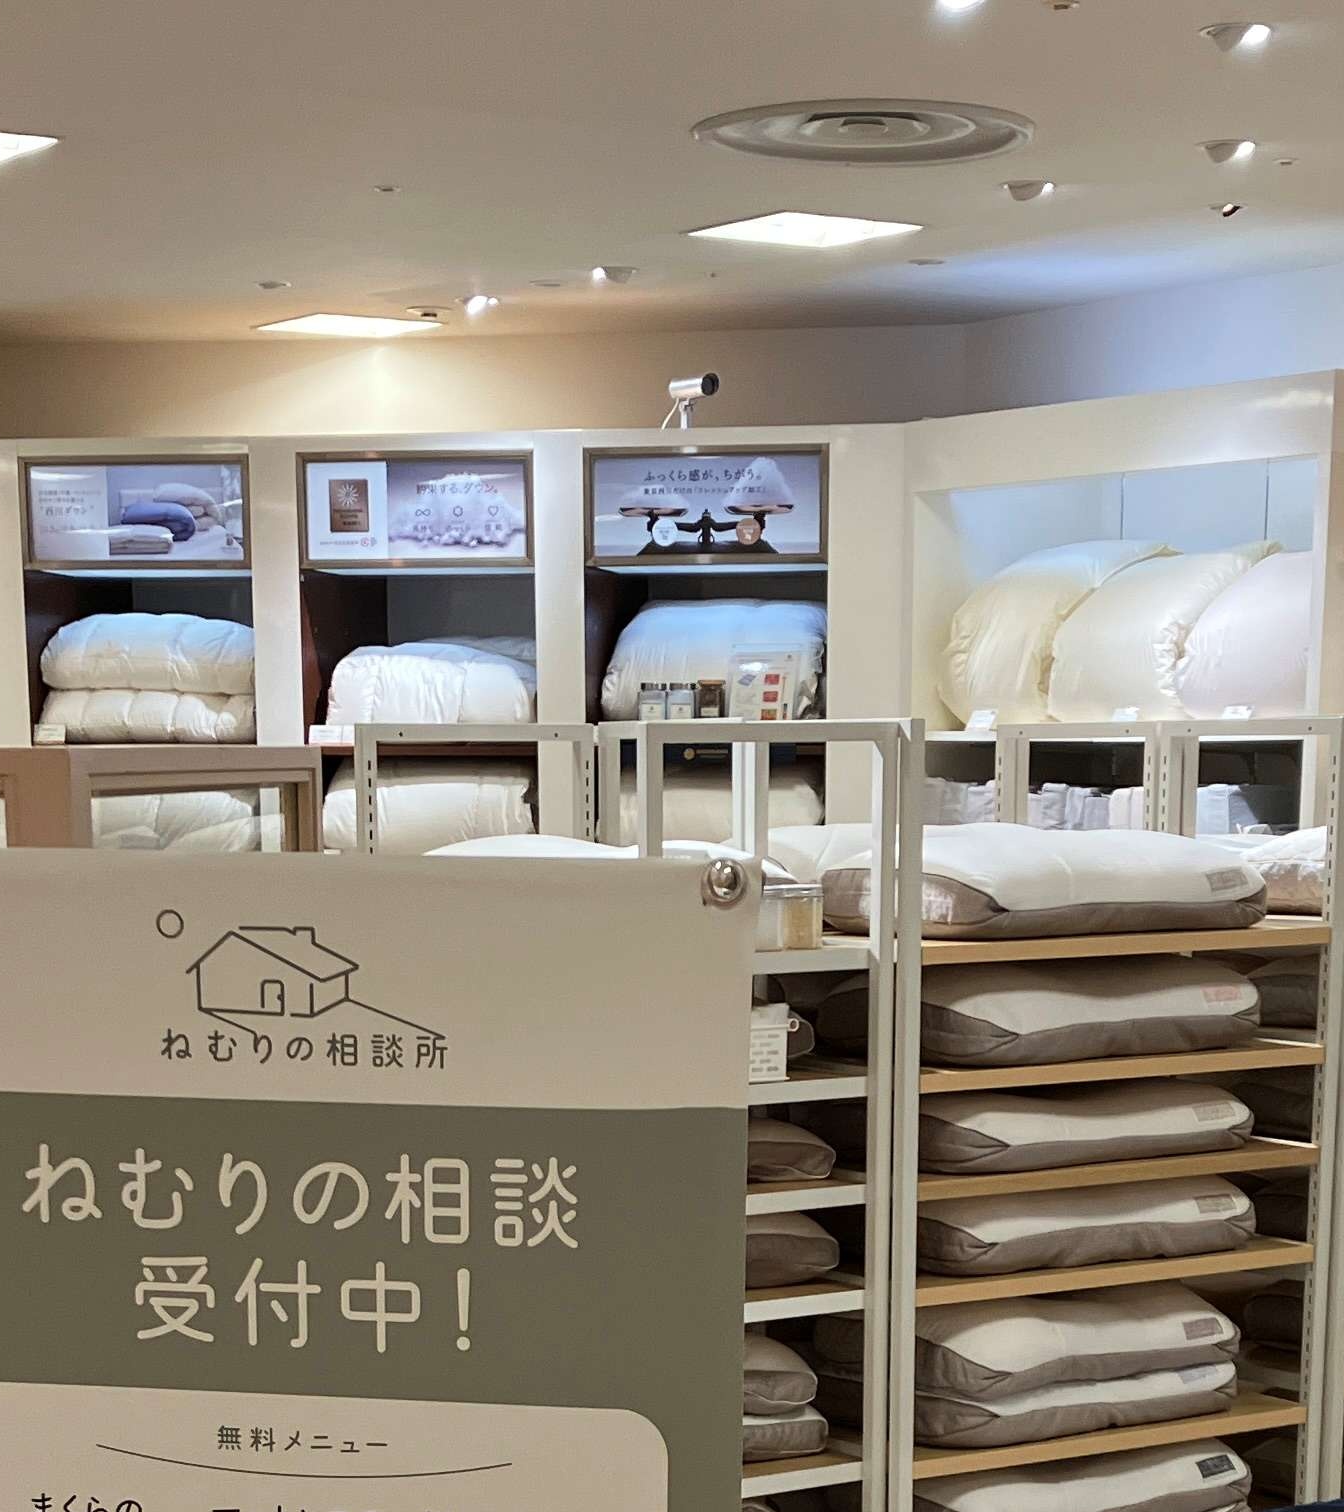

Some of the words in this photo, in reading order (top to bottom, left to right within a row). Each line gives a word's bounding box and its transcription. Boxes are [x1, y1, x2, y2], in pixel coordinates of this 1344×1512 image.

[160, 1028, 449, 1070] ねむりの相談所
[20, 1142, 580, 1250] ねむりの相談
[135, 1256, 473, 1355] 受付中！
[216, 1424, 389, 1455] 無料メニュー
